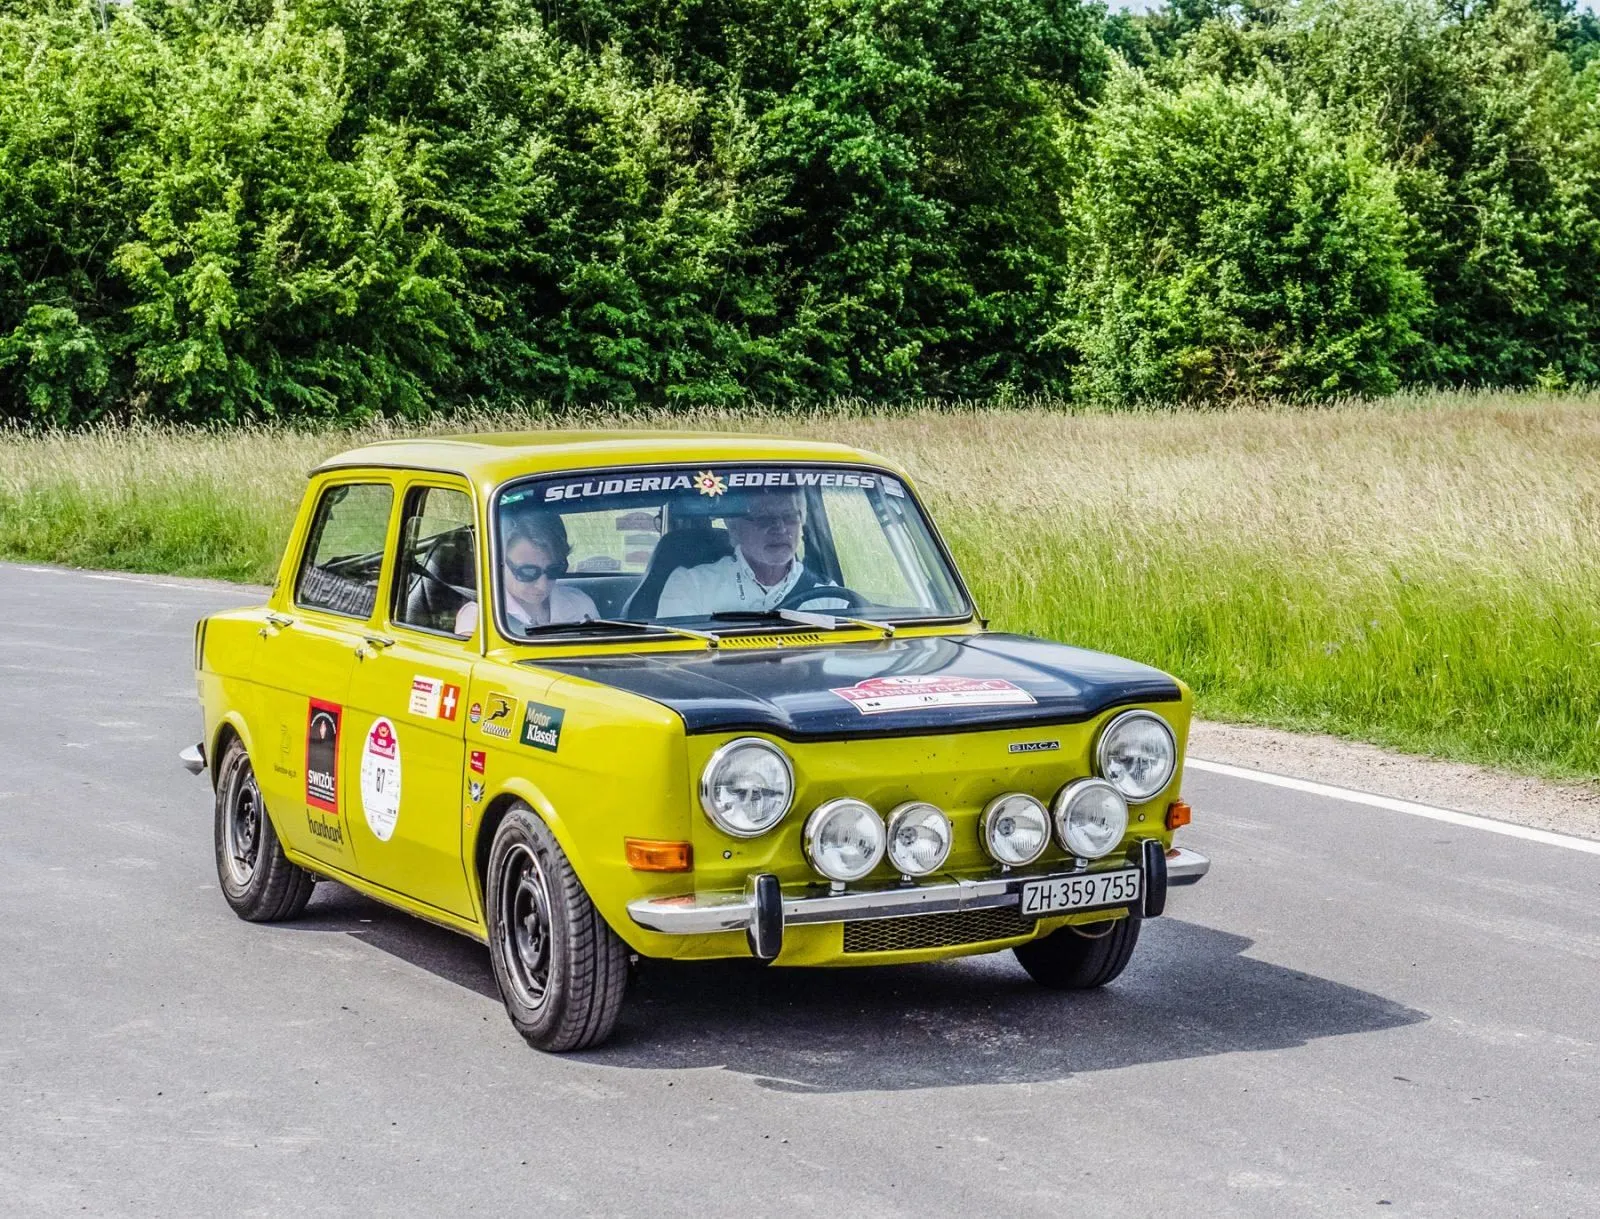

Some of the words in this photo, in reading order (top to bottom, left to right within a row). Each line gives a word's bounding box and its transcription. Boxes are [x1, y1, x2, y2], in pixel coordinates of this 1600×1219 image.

[544, 478, 694, 502] SCUDERIA
[728, 472, 876, 489] EDELWEISS
[525, 707, 552, 727] Motor
[526, 723, 558, 747] Klassik
[1011, 742, 1059, 751] SIMCA
[306, 807, 344, 846] hanhart
[1101, 874, 1137, 902] 755
